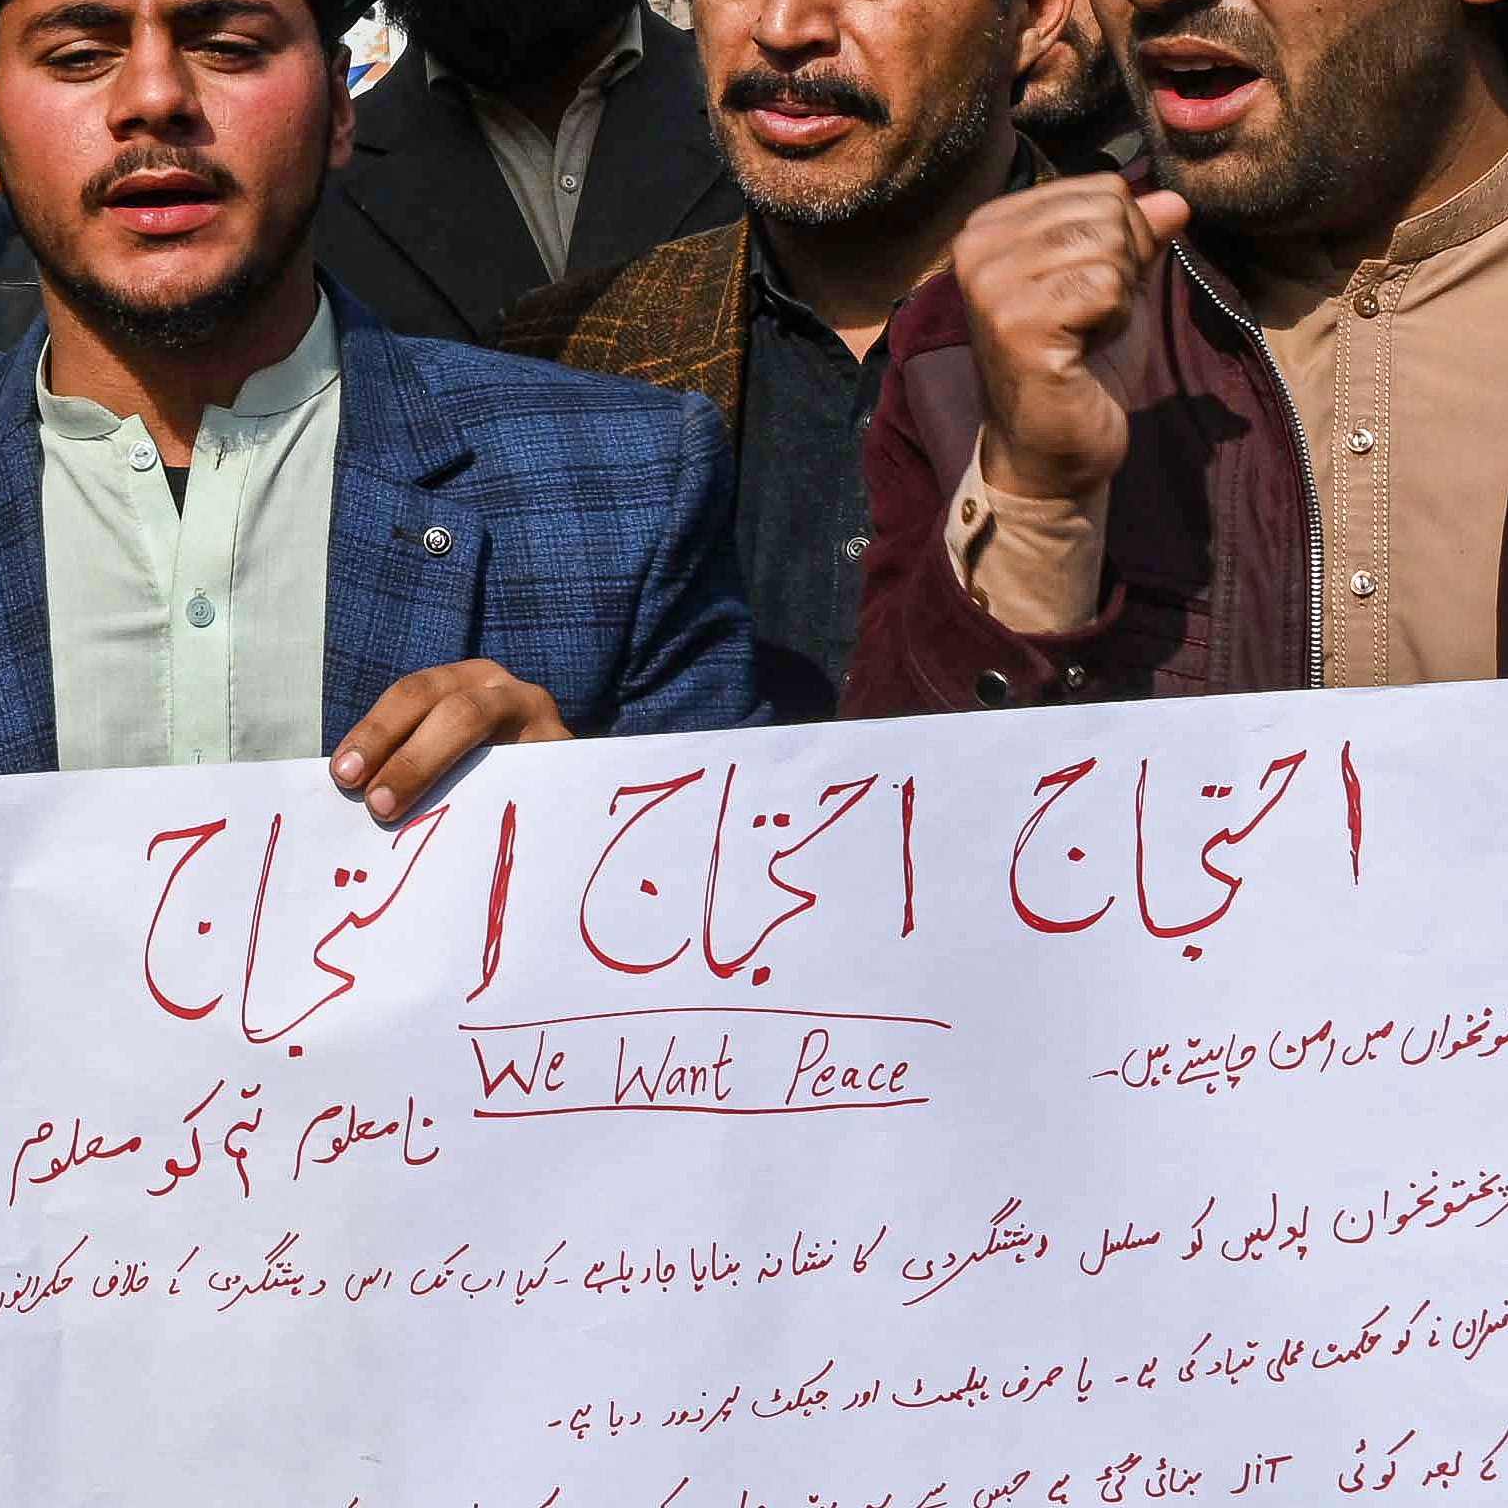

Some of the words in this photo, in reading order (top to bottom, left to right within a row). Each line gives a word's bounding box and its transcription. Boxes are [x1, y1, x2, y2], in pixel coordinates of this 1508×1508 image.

[579, 763, 916, 987] احتجاج
[1009, 740, 1362, 962] احتجاج
[144, 798, 520, 1060] احتجاج
[470, 1028, 567, 1100] We
[614, 1033, 735, 1105] Want
[785, 1027, 910, 1106] Peace
[8, 1118, 142, 1207] معلوم
[146, 1079, 226, 1197] کو
[853, 1224, 887, 1274] کا
[1181, 1196, 1216, 1261] کو
